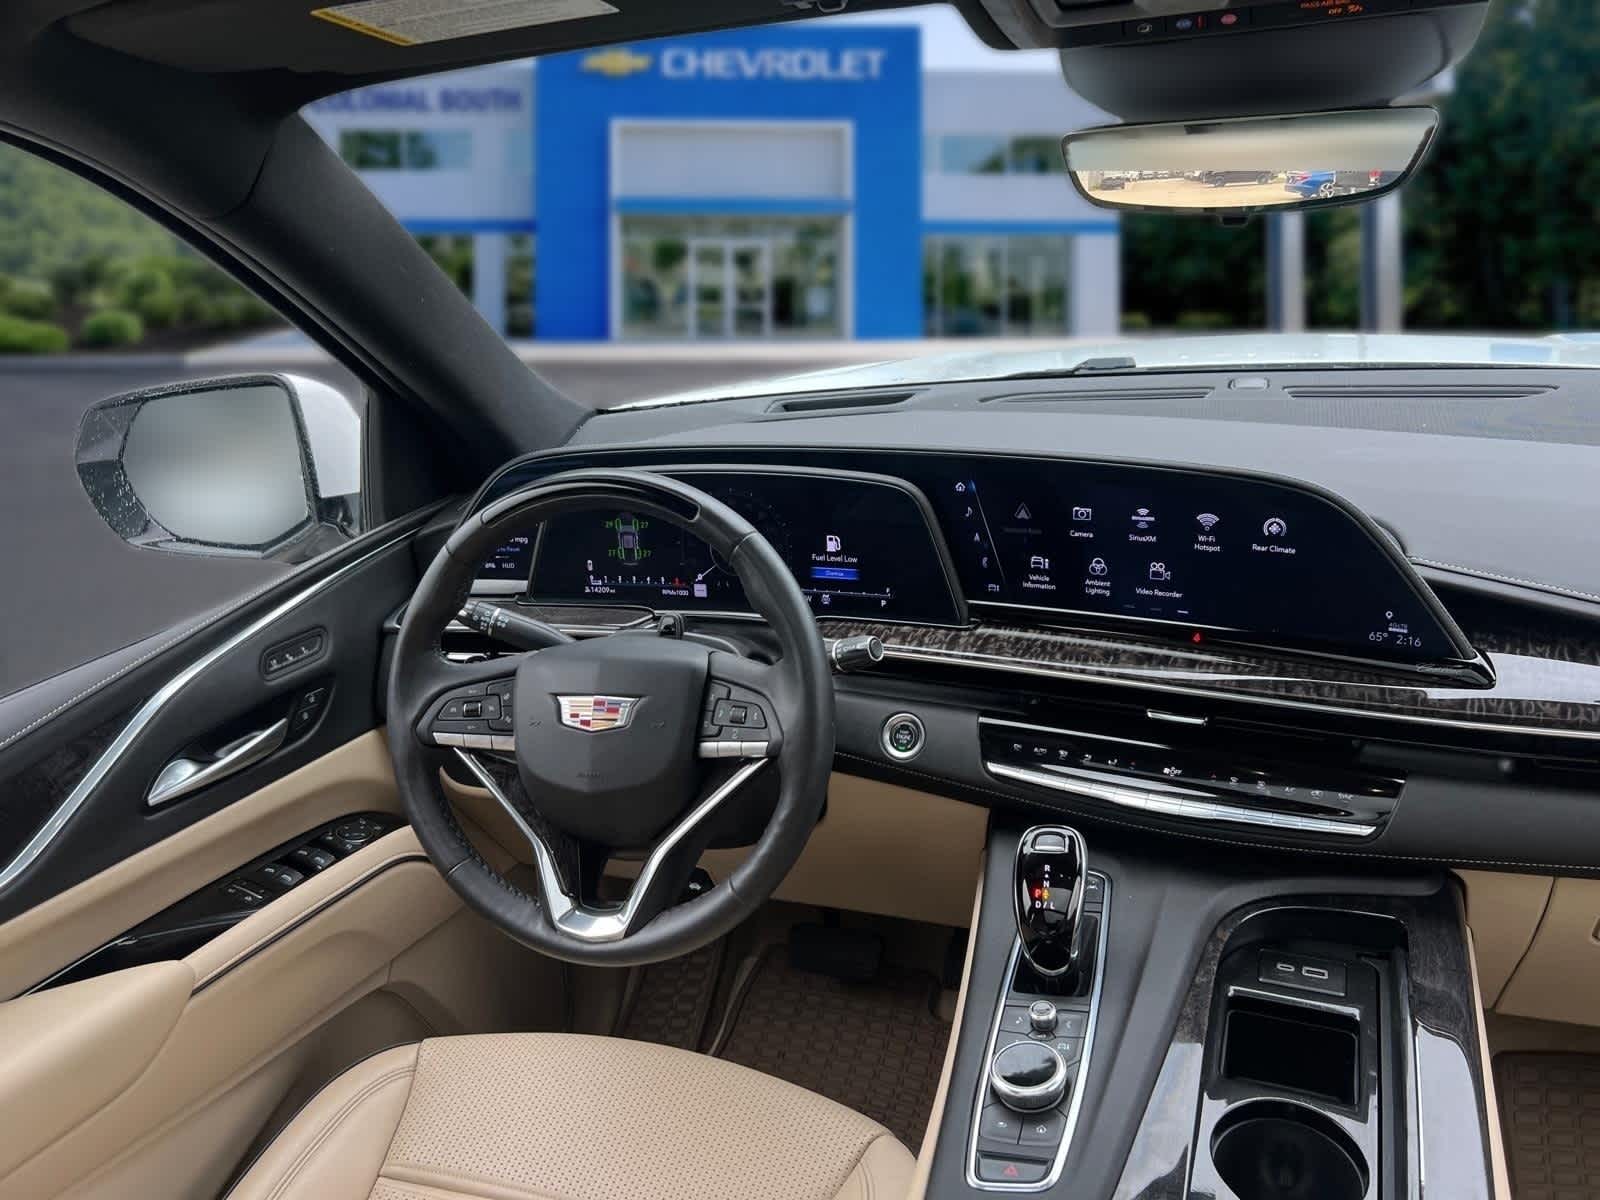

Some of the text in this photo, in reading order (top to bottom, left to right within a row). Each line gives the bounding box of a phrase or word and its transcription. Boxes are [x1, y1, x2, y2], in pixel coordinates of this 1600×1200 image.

[661, 49, 886, 78] CHEVROLET
[1069, 530, 1094, 539] Camera
[1128, 534, 1157, 542] SiriusXM
[514, 536, 529, 545] mpg
[1194, 543, 1221, 552] Hotspot
[1252, 543, 1297, 555] Rear Climate
[811, 553, 826, 561] Fuel
[1028, 573, 1051, 582] Vehicle
[1022, 581, 1057, 590] Information
[1084, 578, 1111, 587] Ambient
[1085, 587, 1111, 597] Lighting
[1135, 587, 1183, 598] Video Recorder
[1368, 631, 1422, 647] 65° 2:16
[1044, 864, 1051, 872] R
[1043, 880, 1050, 888] N
[1035, 889, 1042, 898] P
